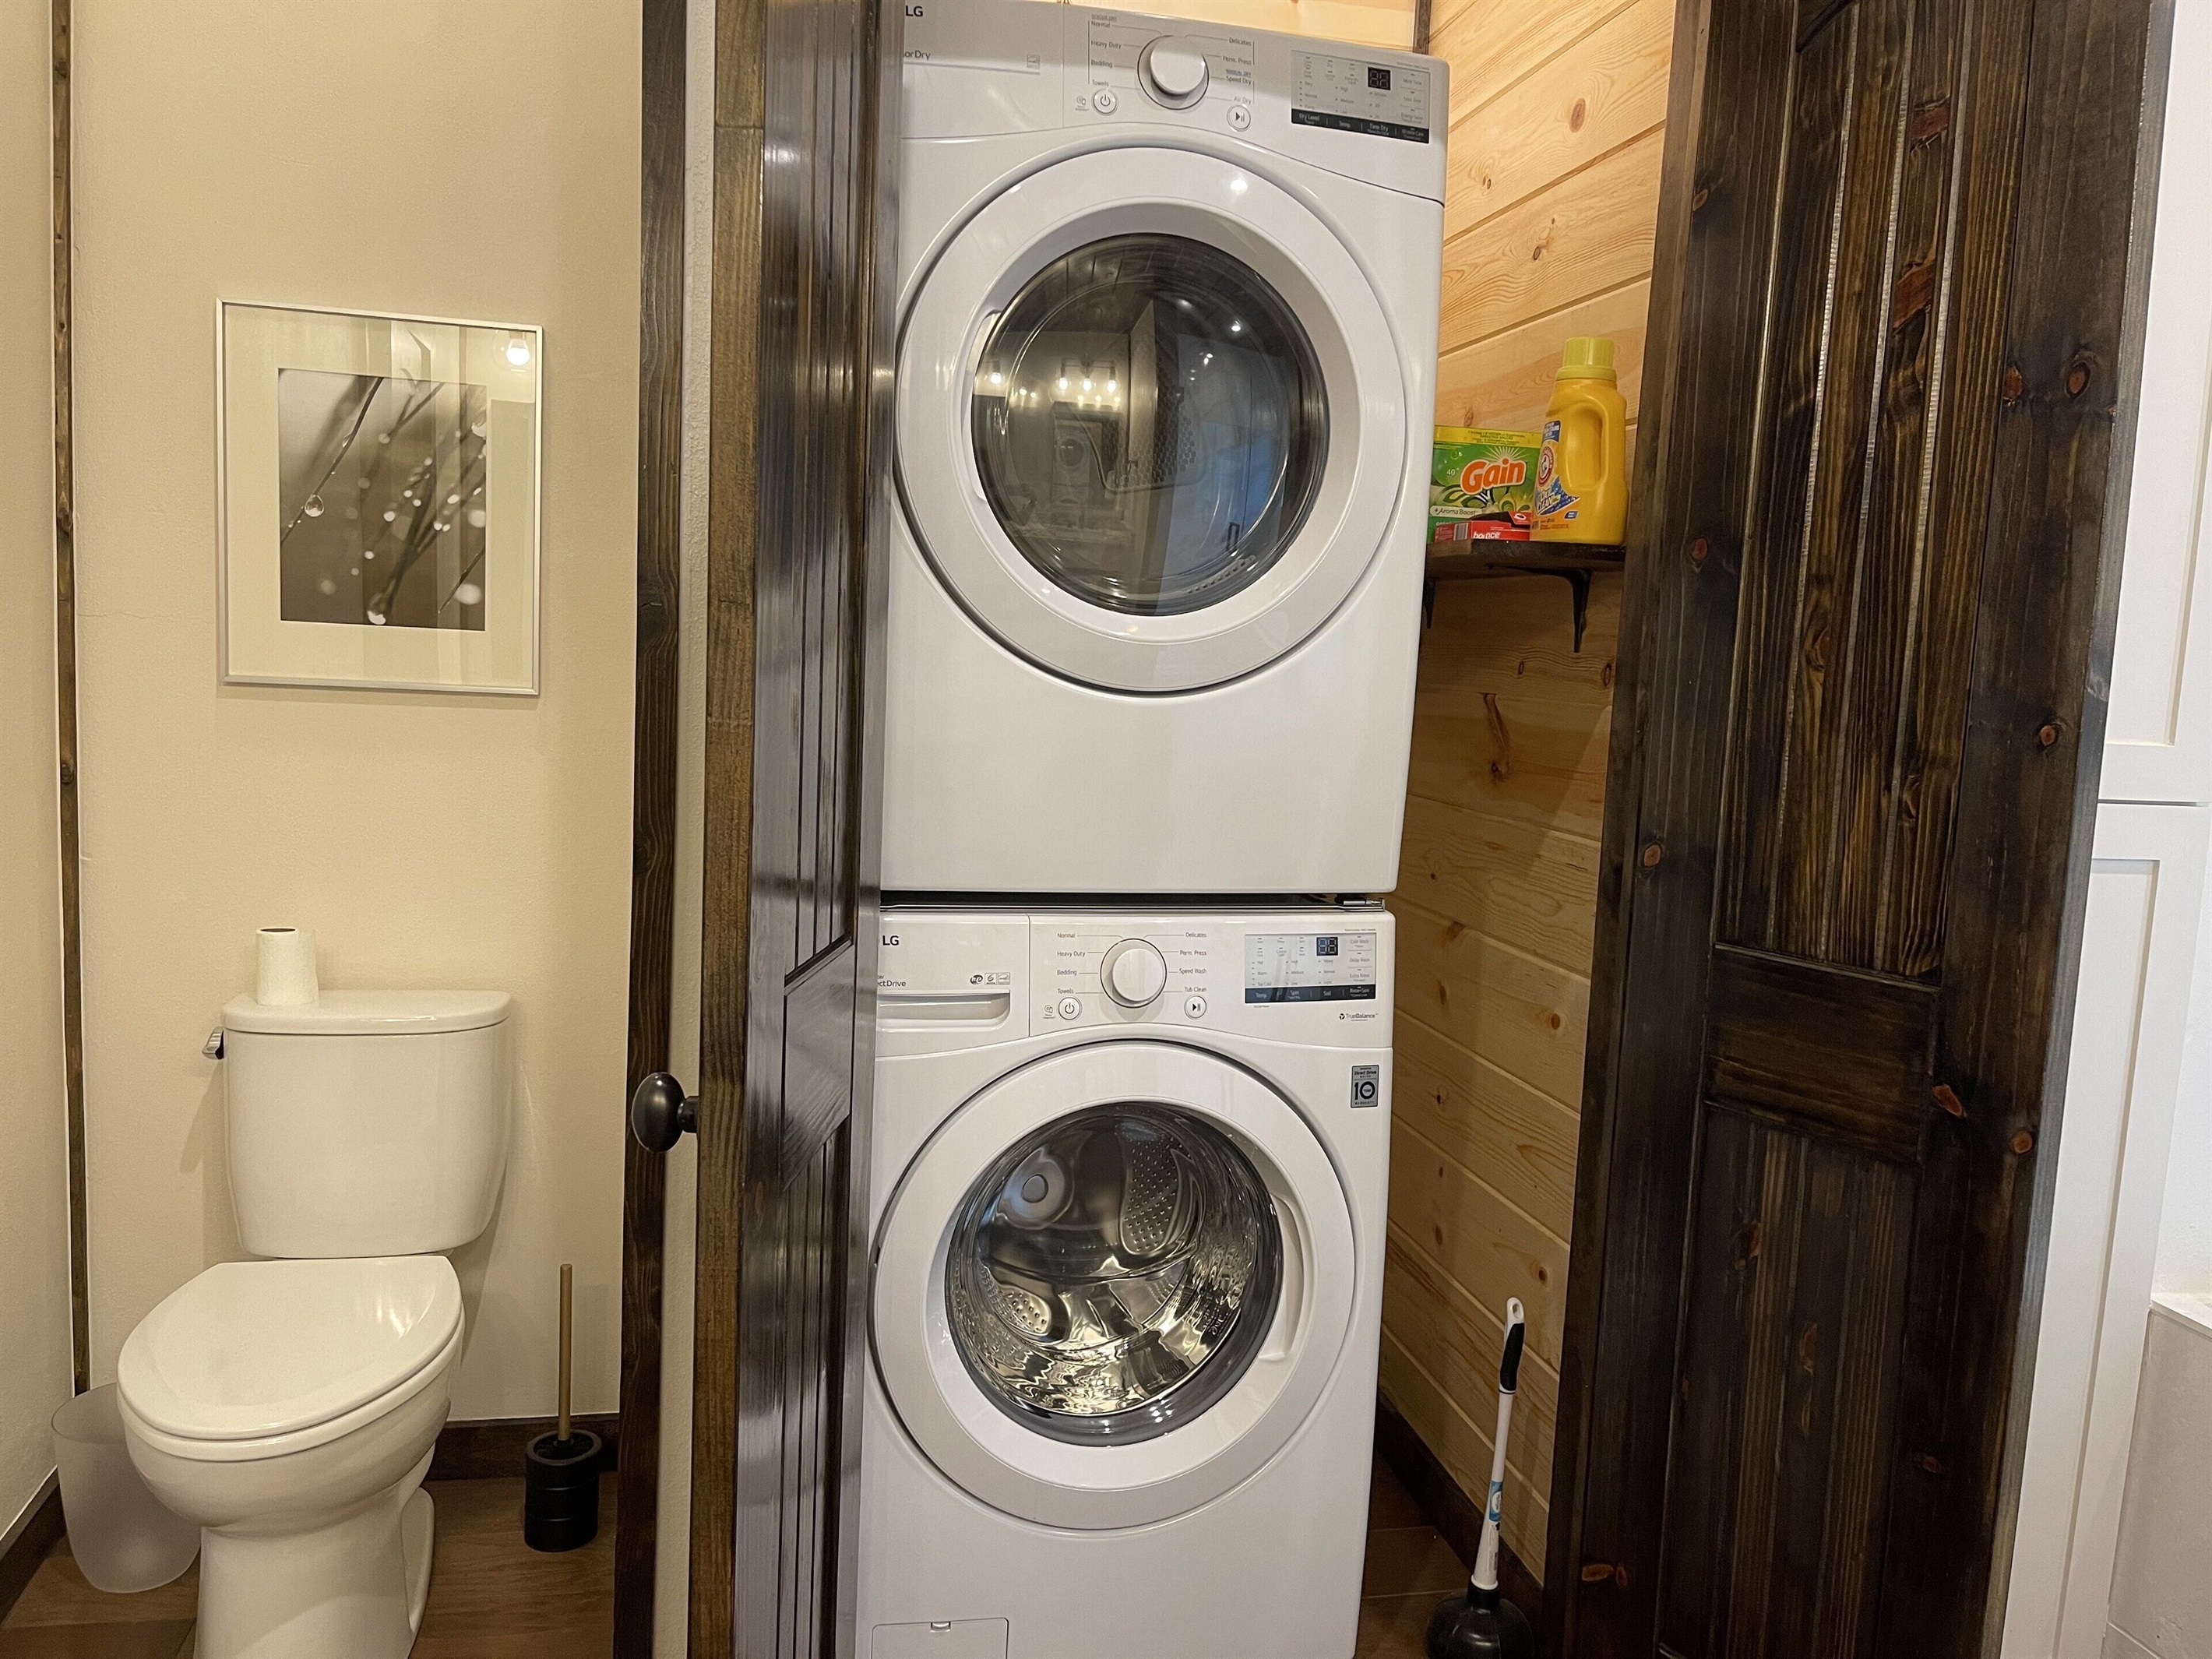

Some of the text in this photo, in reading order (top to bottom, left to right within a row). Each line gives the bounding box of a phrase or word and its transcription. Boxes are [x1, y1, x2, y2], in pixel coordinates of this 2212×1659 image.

[905, 5, 924, 17] LG
[1090, 40, 1122, 50] Heavy Duty
[1228, 37, 1252, 46] Delicates
[1090, 58, 1113, 69] Bedding
[1238, 57, 1252, 65] Press
[1092, 79, 1109, 87] Towels
[1242, 77, 1252, 86] Dry
[1461, 457, 1526, 493] Gain
[882, 935, 900, 946] LG
[1354, 1081, 1375, 1100] 10
